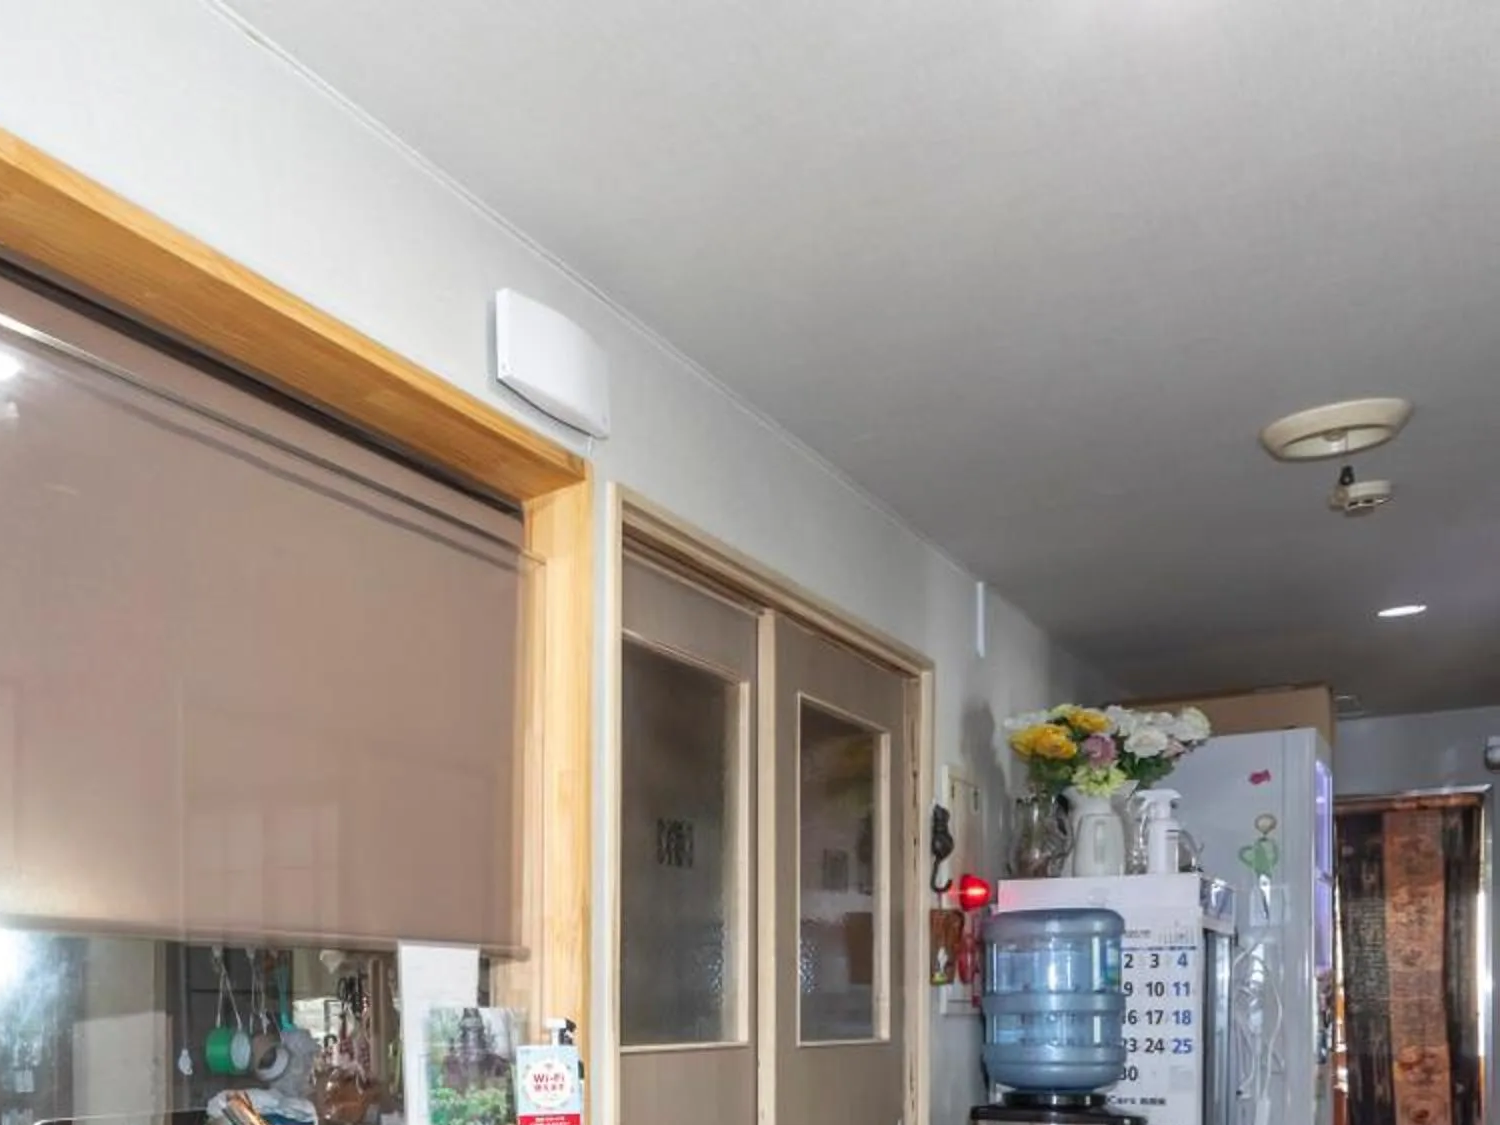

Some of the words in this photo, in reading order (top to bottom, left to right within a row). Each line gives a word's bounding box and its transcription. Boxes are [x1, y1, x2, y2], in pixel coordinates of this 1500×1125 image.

[1124, 954, 1134, 969] 2
[1150, 954, 1160, 969] 3
[1177, 953, 1189, 968] 4
[1123, 982, 1134, 997] 9
[1146, 982, 1165, 997] 10
[1173, 982, 1191, 997] 11
[1145, 1010, 1165, 1025] 17
[1172, 1010, 1192, 1025] 18
[1122, 1038, 1138, 1053] 3
[1144, 1038, 1165, 1053] 24
[1171, 1038, 1193, 1054] 25
